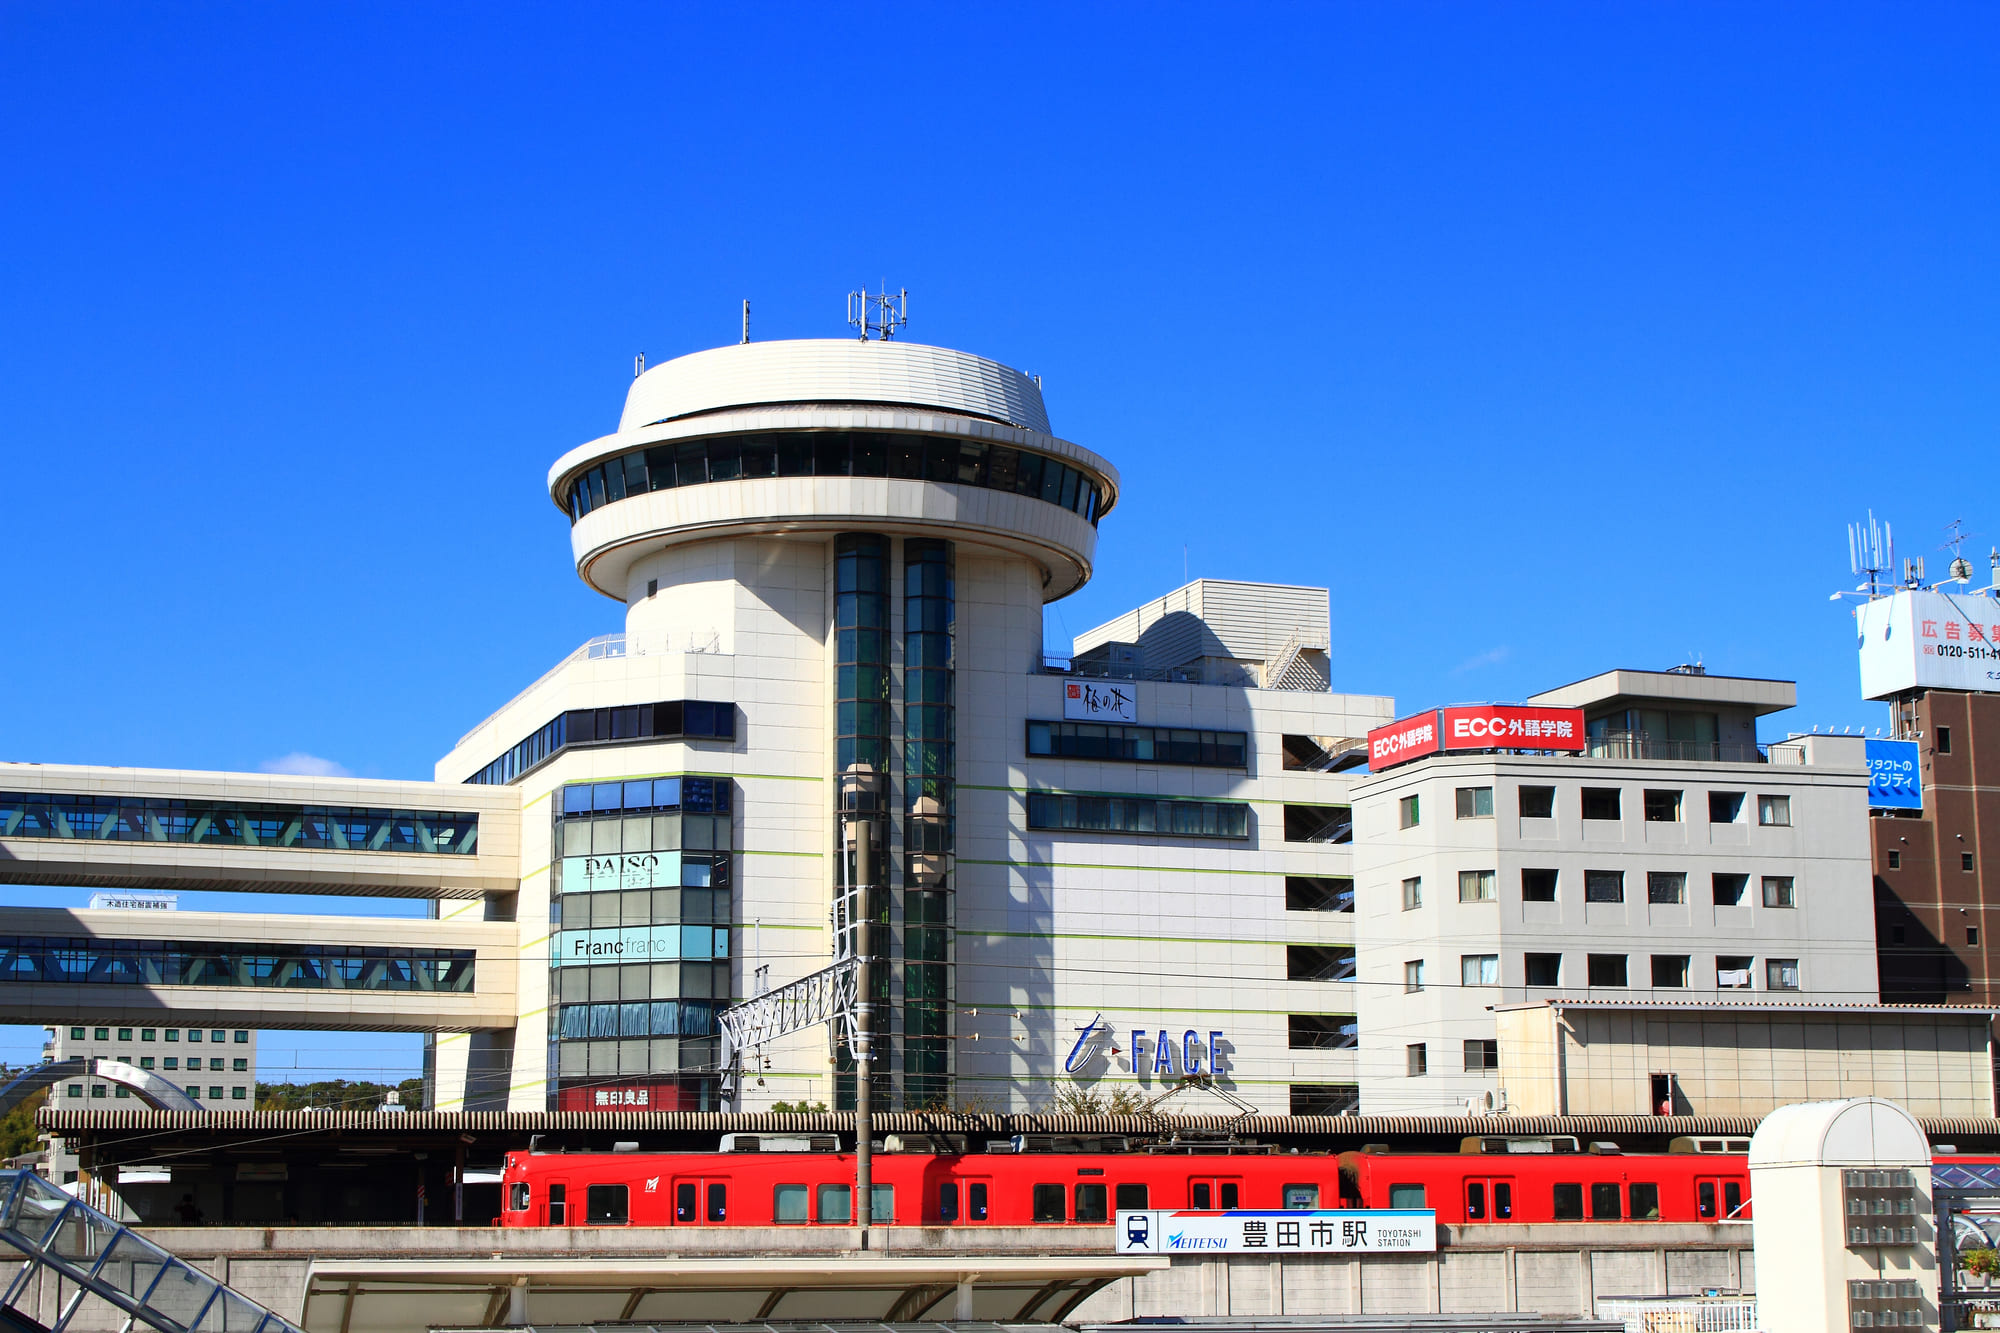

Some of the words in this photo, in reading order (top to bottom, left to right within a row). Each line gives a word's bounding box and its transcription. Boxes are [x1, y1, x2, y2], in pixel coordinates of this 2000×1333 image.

[584, 855, 659, 875] DAISO
[1130, 1029, 1224, 1075] FACE
[595, 1089, 649, 1106] 無印良品
[1166, 1230, 1228, 1249] MEITETSU
[1243, 1220, 1368, 1248] 豊田市駅
[1377, 1229, 1422, 1238] TOYOTASHI
[1377, 1238, 1411, 1247] STATION
